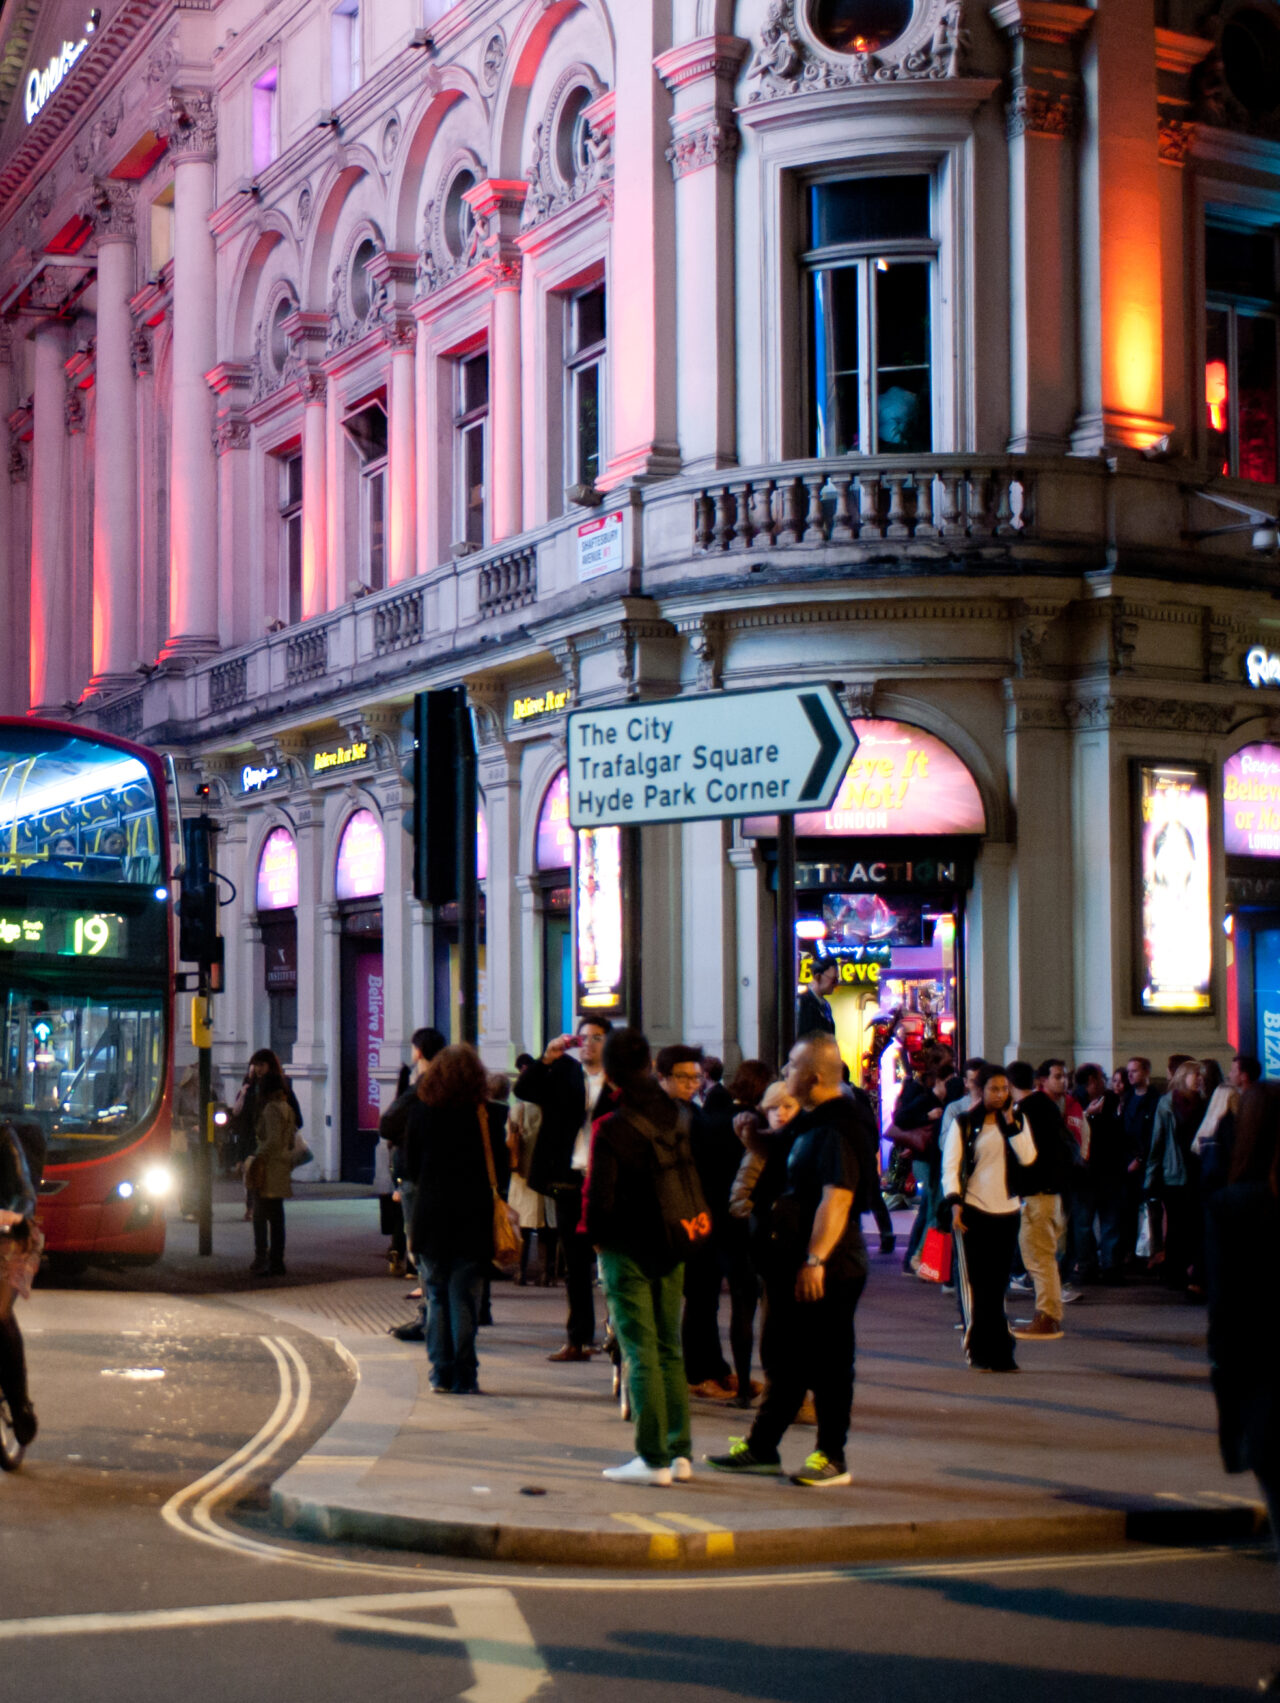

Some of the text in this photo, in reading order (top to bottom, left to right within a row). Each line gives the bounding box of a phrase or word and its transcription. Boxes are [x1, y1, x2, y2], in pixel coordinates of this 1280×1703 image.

[581, 529, 618, 552] SHAFTESBURY
[582, 549, 602, 565] AVENUE
[578, 717, 673, 747] The City
[578, 745, 779, 780] Trafalgar Square
[901, 749, 929, 779] It
[577, 778, 790, 817] Hyde Park Corner
[841, 780, 910, 810] Not!
[1224, 774, 1280, 801] Believ
[824, 812, 888, 830] LONDON
[1234, 805, 1280, 832] or No
[1248, 832, 1280, 850] LONDO
[797, 861, 956, 884] TTRACTION
[74, 917, 109, 955] 19
[799, 957, 881, 984] Bieve
[368, 973, 384, 1032] Believe
[1263, 1010, 1280, 1079] BIZA
[680, 1211, 710, 1241] Y-3
